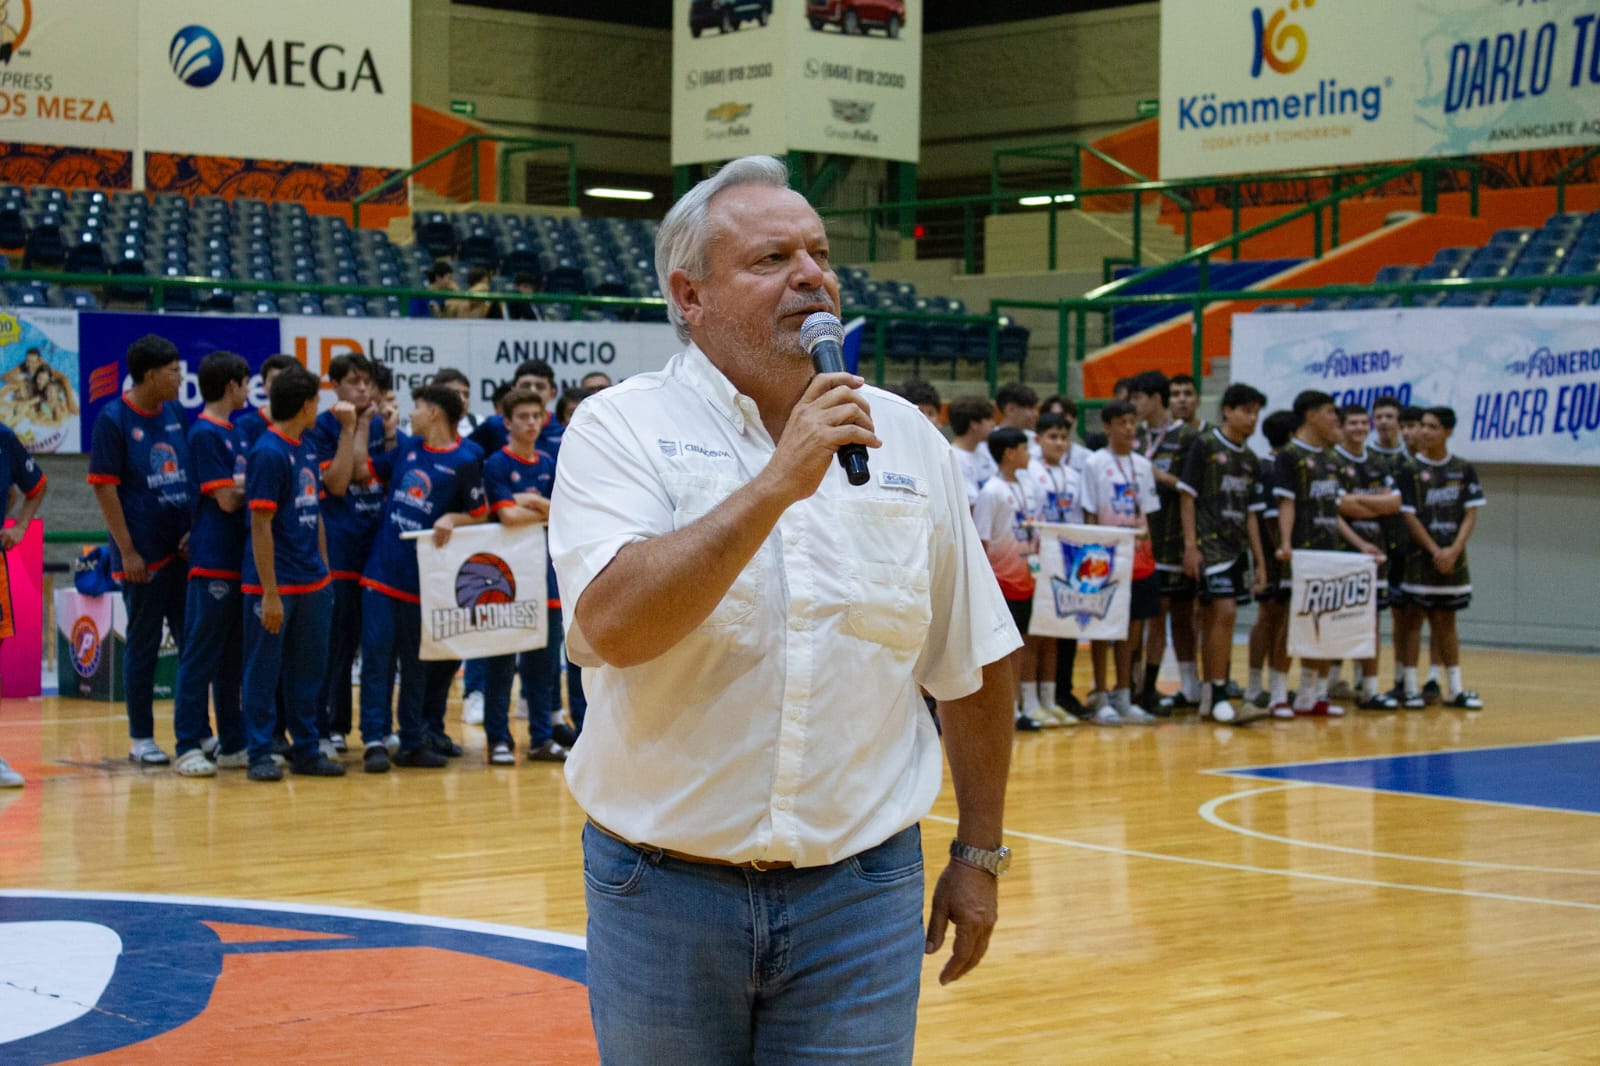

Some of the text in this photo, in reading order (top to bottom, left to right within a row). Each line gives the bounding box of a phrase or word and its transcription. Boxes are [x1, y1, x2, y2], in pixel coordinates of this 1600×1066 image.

[0, 71, 53, 91] PRESS
[232, 36, 384, 95] MEGA
[1443, 21, 1557, 114] DARLO
[37, 95, 115, 123] MEZA
[1178, 79, 1382, 130] Kömmerling
[368, 337, 435, 364] Línea
[495, 339, 617, 365] ANUNCIO
[1471, 388, 1549, 442] HACER
[1299, 569, 1373, 617] RAYOS
[431, 600, 538, 643] HALCONES
